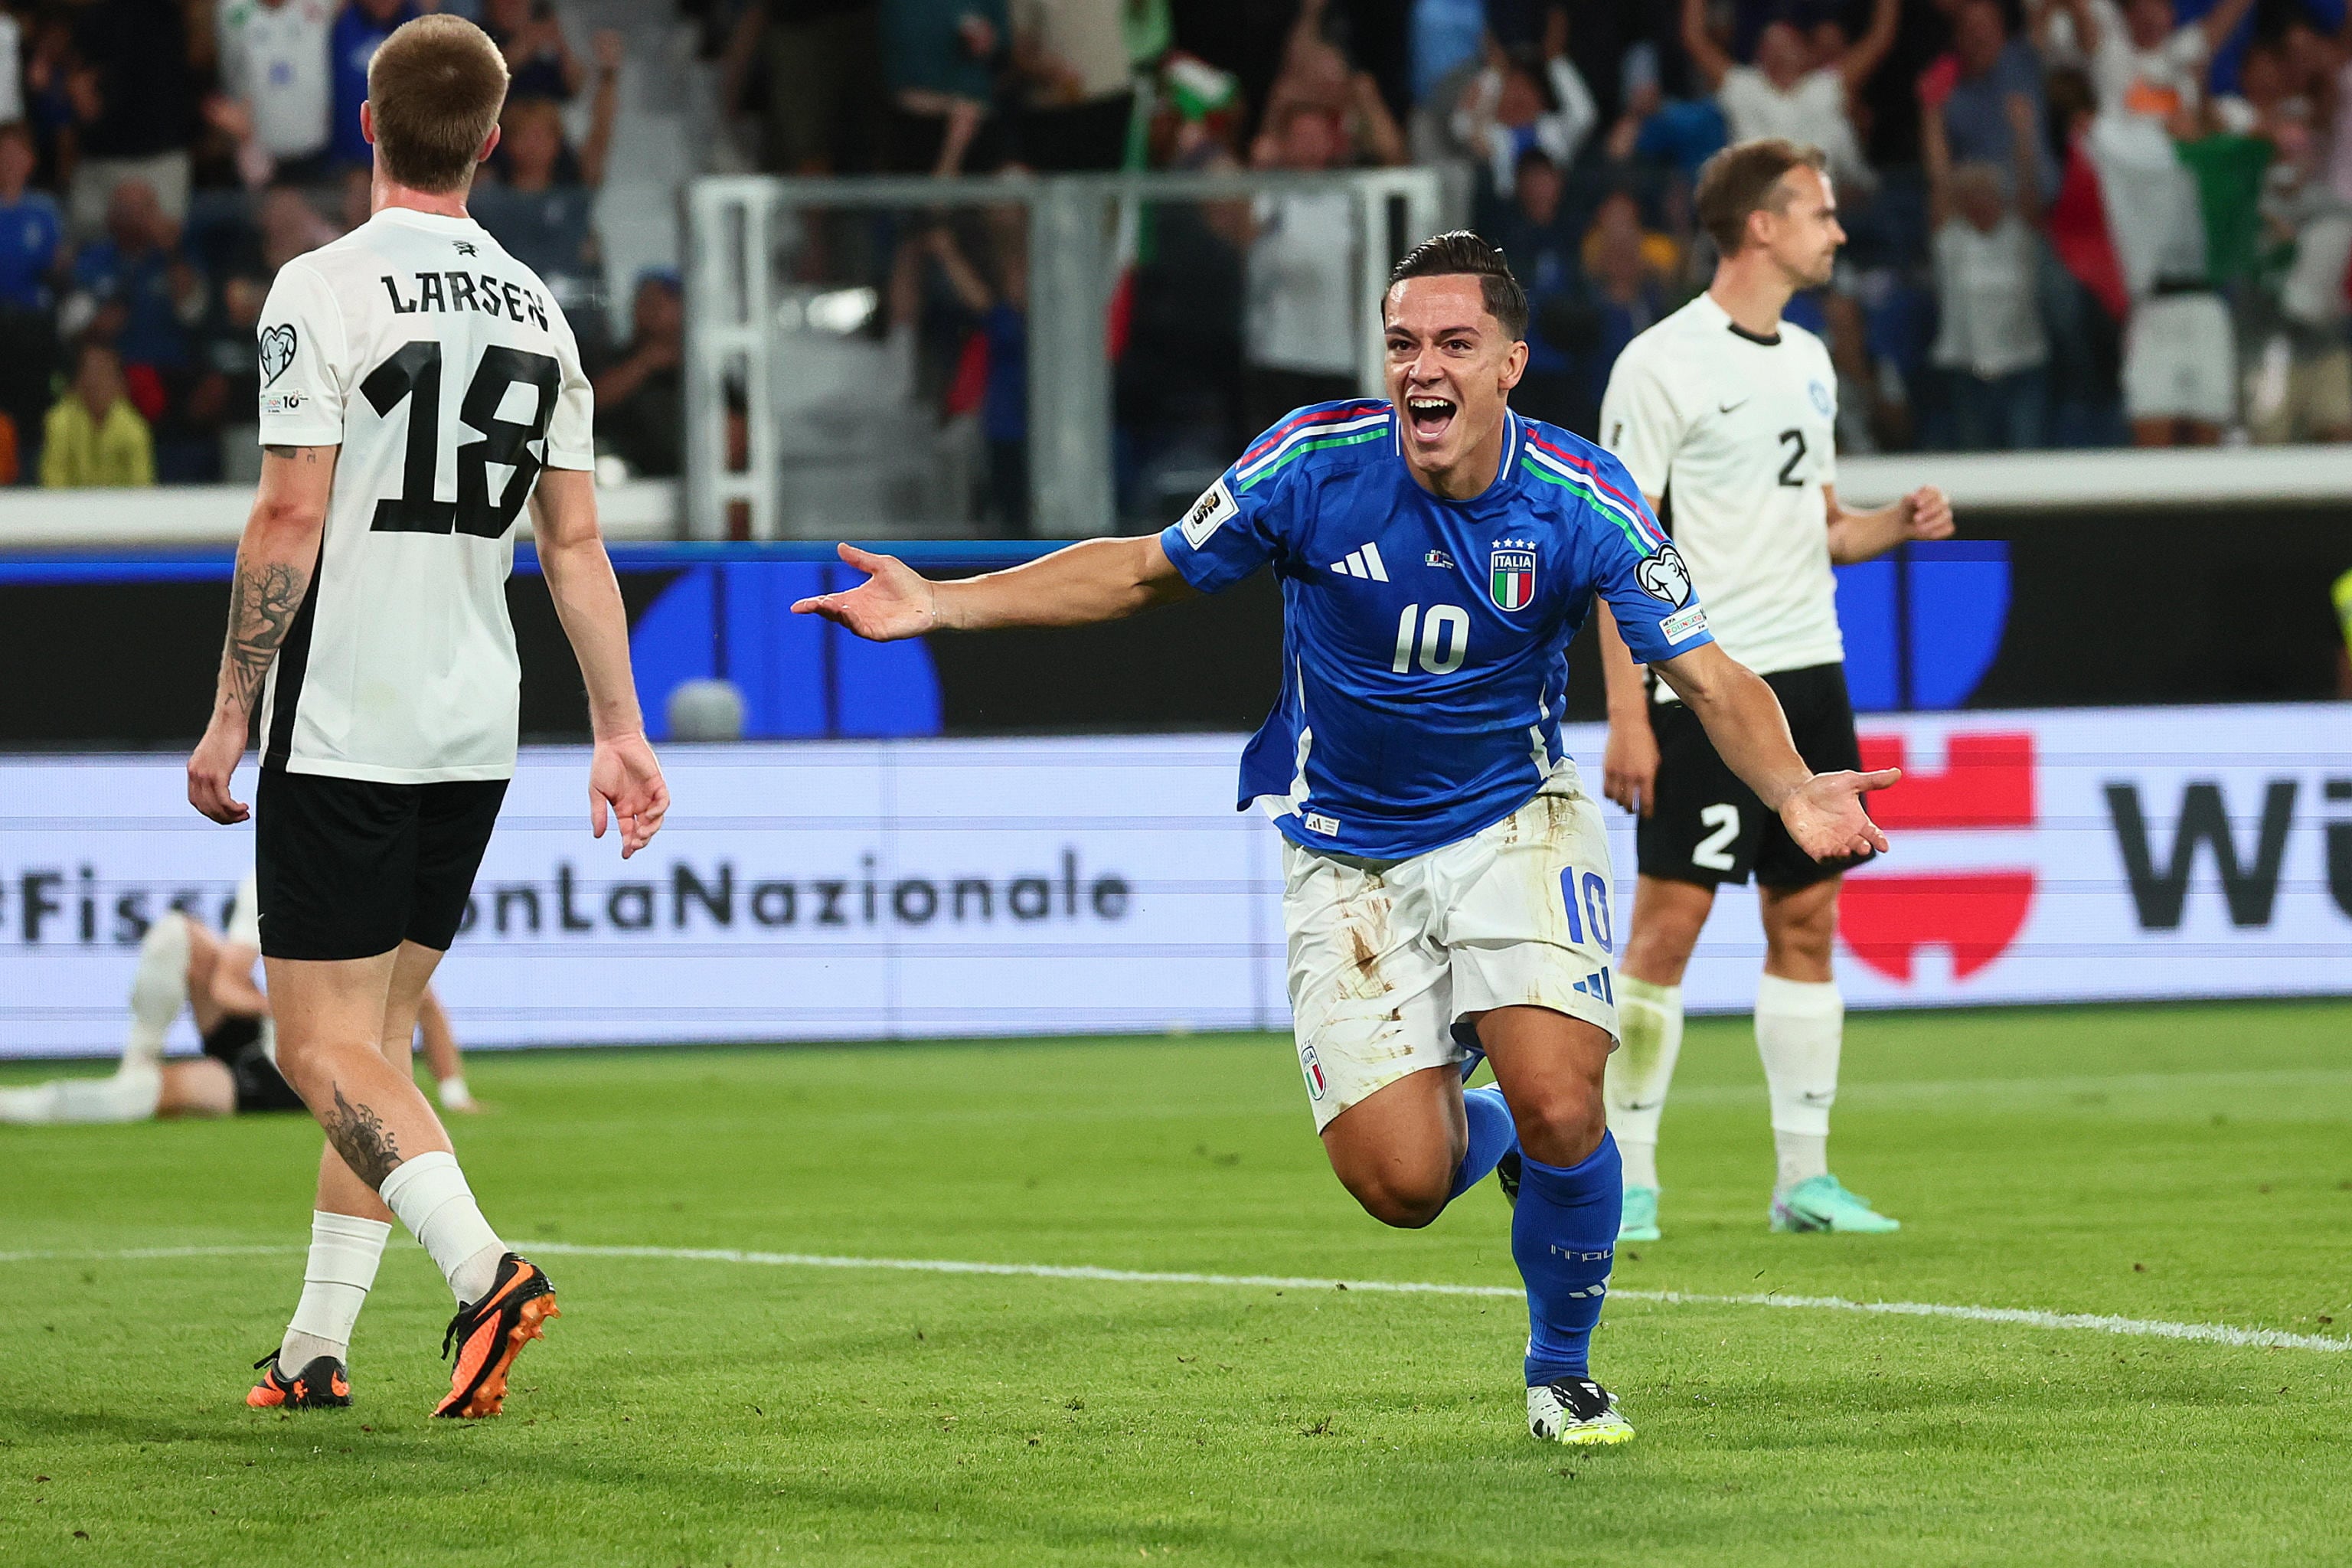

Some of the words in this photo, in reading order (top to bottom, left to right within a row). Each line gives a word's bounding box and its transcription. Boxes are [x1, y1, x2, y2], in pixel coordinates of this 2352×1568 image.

[381, 270, 550, 332] LARSEN
[359, 341, 562, 539] 18
[1779, 430, 1806, 487] 2
[1494, 555, 1532, 567] ITALIA
[1392, 603, 1470, 675] 10
[1690, 803, 1740, 871] 2
[2105, 778, 2352, 929] W
[1560, 866, 1612, 954] 10
